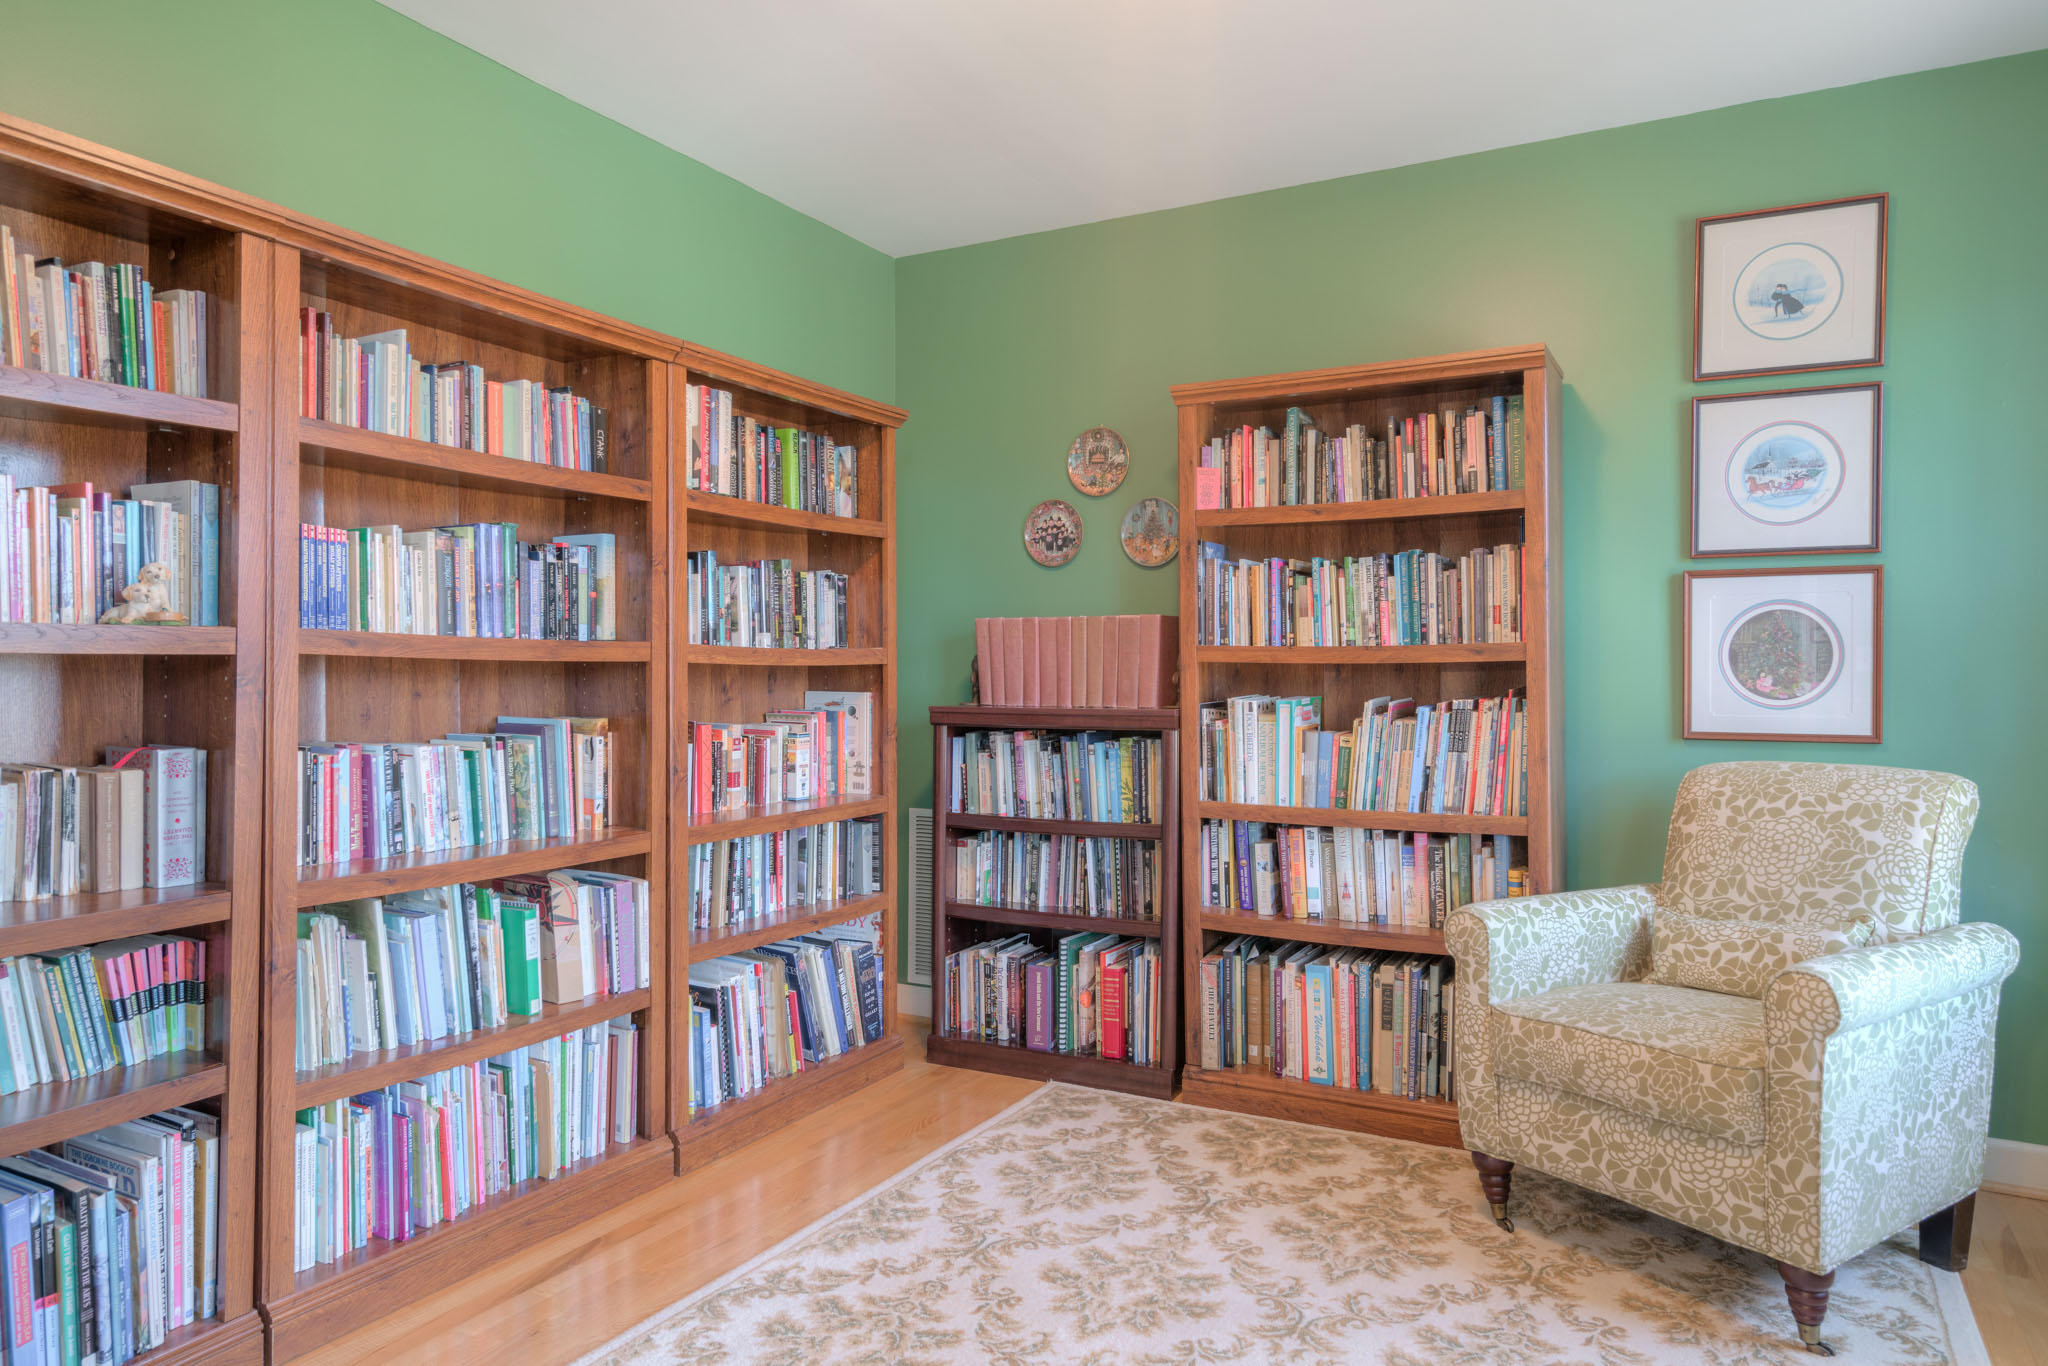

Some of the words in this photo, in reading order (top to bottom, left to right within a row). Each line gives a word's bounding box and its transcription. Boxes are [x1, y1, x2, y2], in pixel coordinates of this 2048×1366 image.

[1435, 864, 1443, 884] Politics
[1436, 893, 1444, 920] CANCER
[839, 974, 847, 994] NATION
[1314, 1015, 1323, 1062] Workbook
[80, 1196, 89, 1228] REALITY
[81, 1229, 90, 1269] THROUGH
[82, 1270, 91, 1286] THE
[83, 1288, 91, 1308] ARTS
